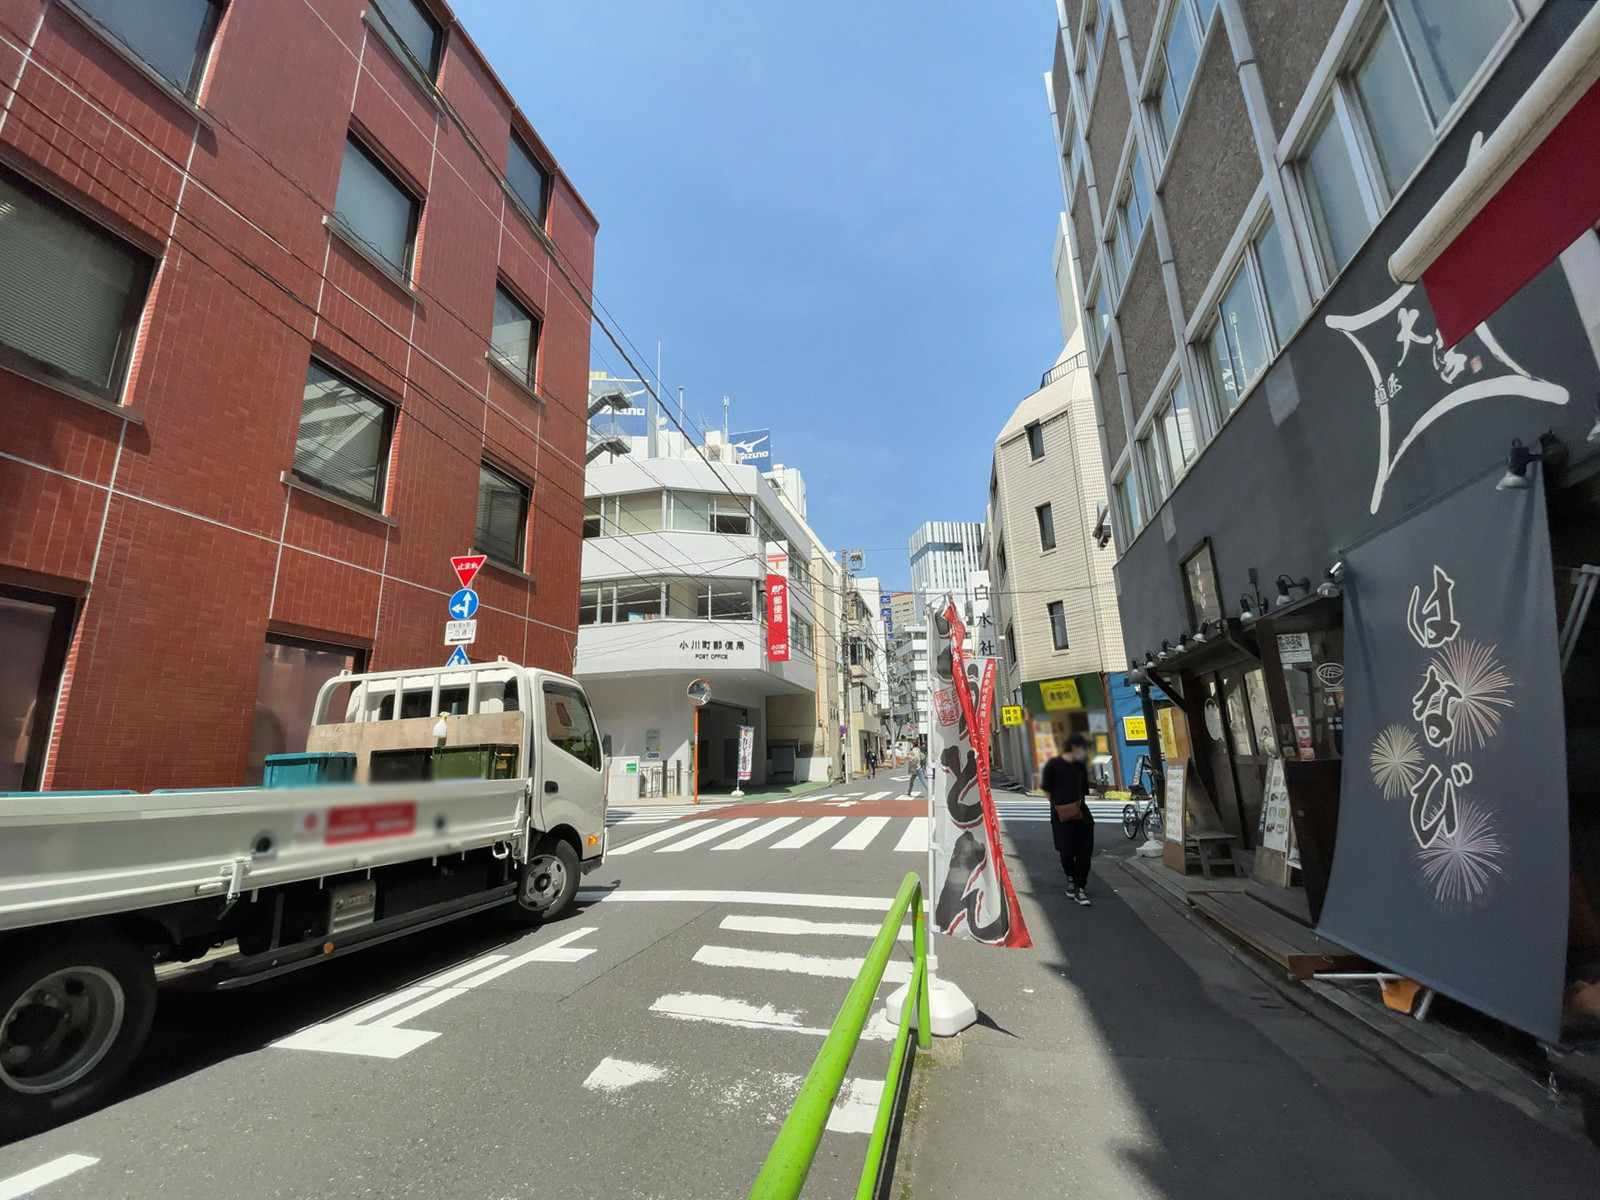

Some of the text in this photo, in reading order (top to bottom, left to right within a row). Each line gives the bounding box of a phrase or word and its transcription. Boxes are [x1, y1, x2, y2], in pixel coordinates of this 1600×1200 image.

[458, 562, 478, 570] 止まれ
[974, 584, 996, 656] 白水社
[679, 640, 745, 651] 小川町郵便局
[1407, 565, 1472, 849] はなび
